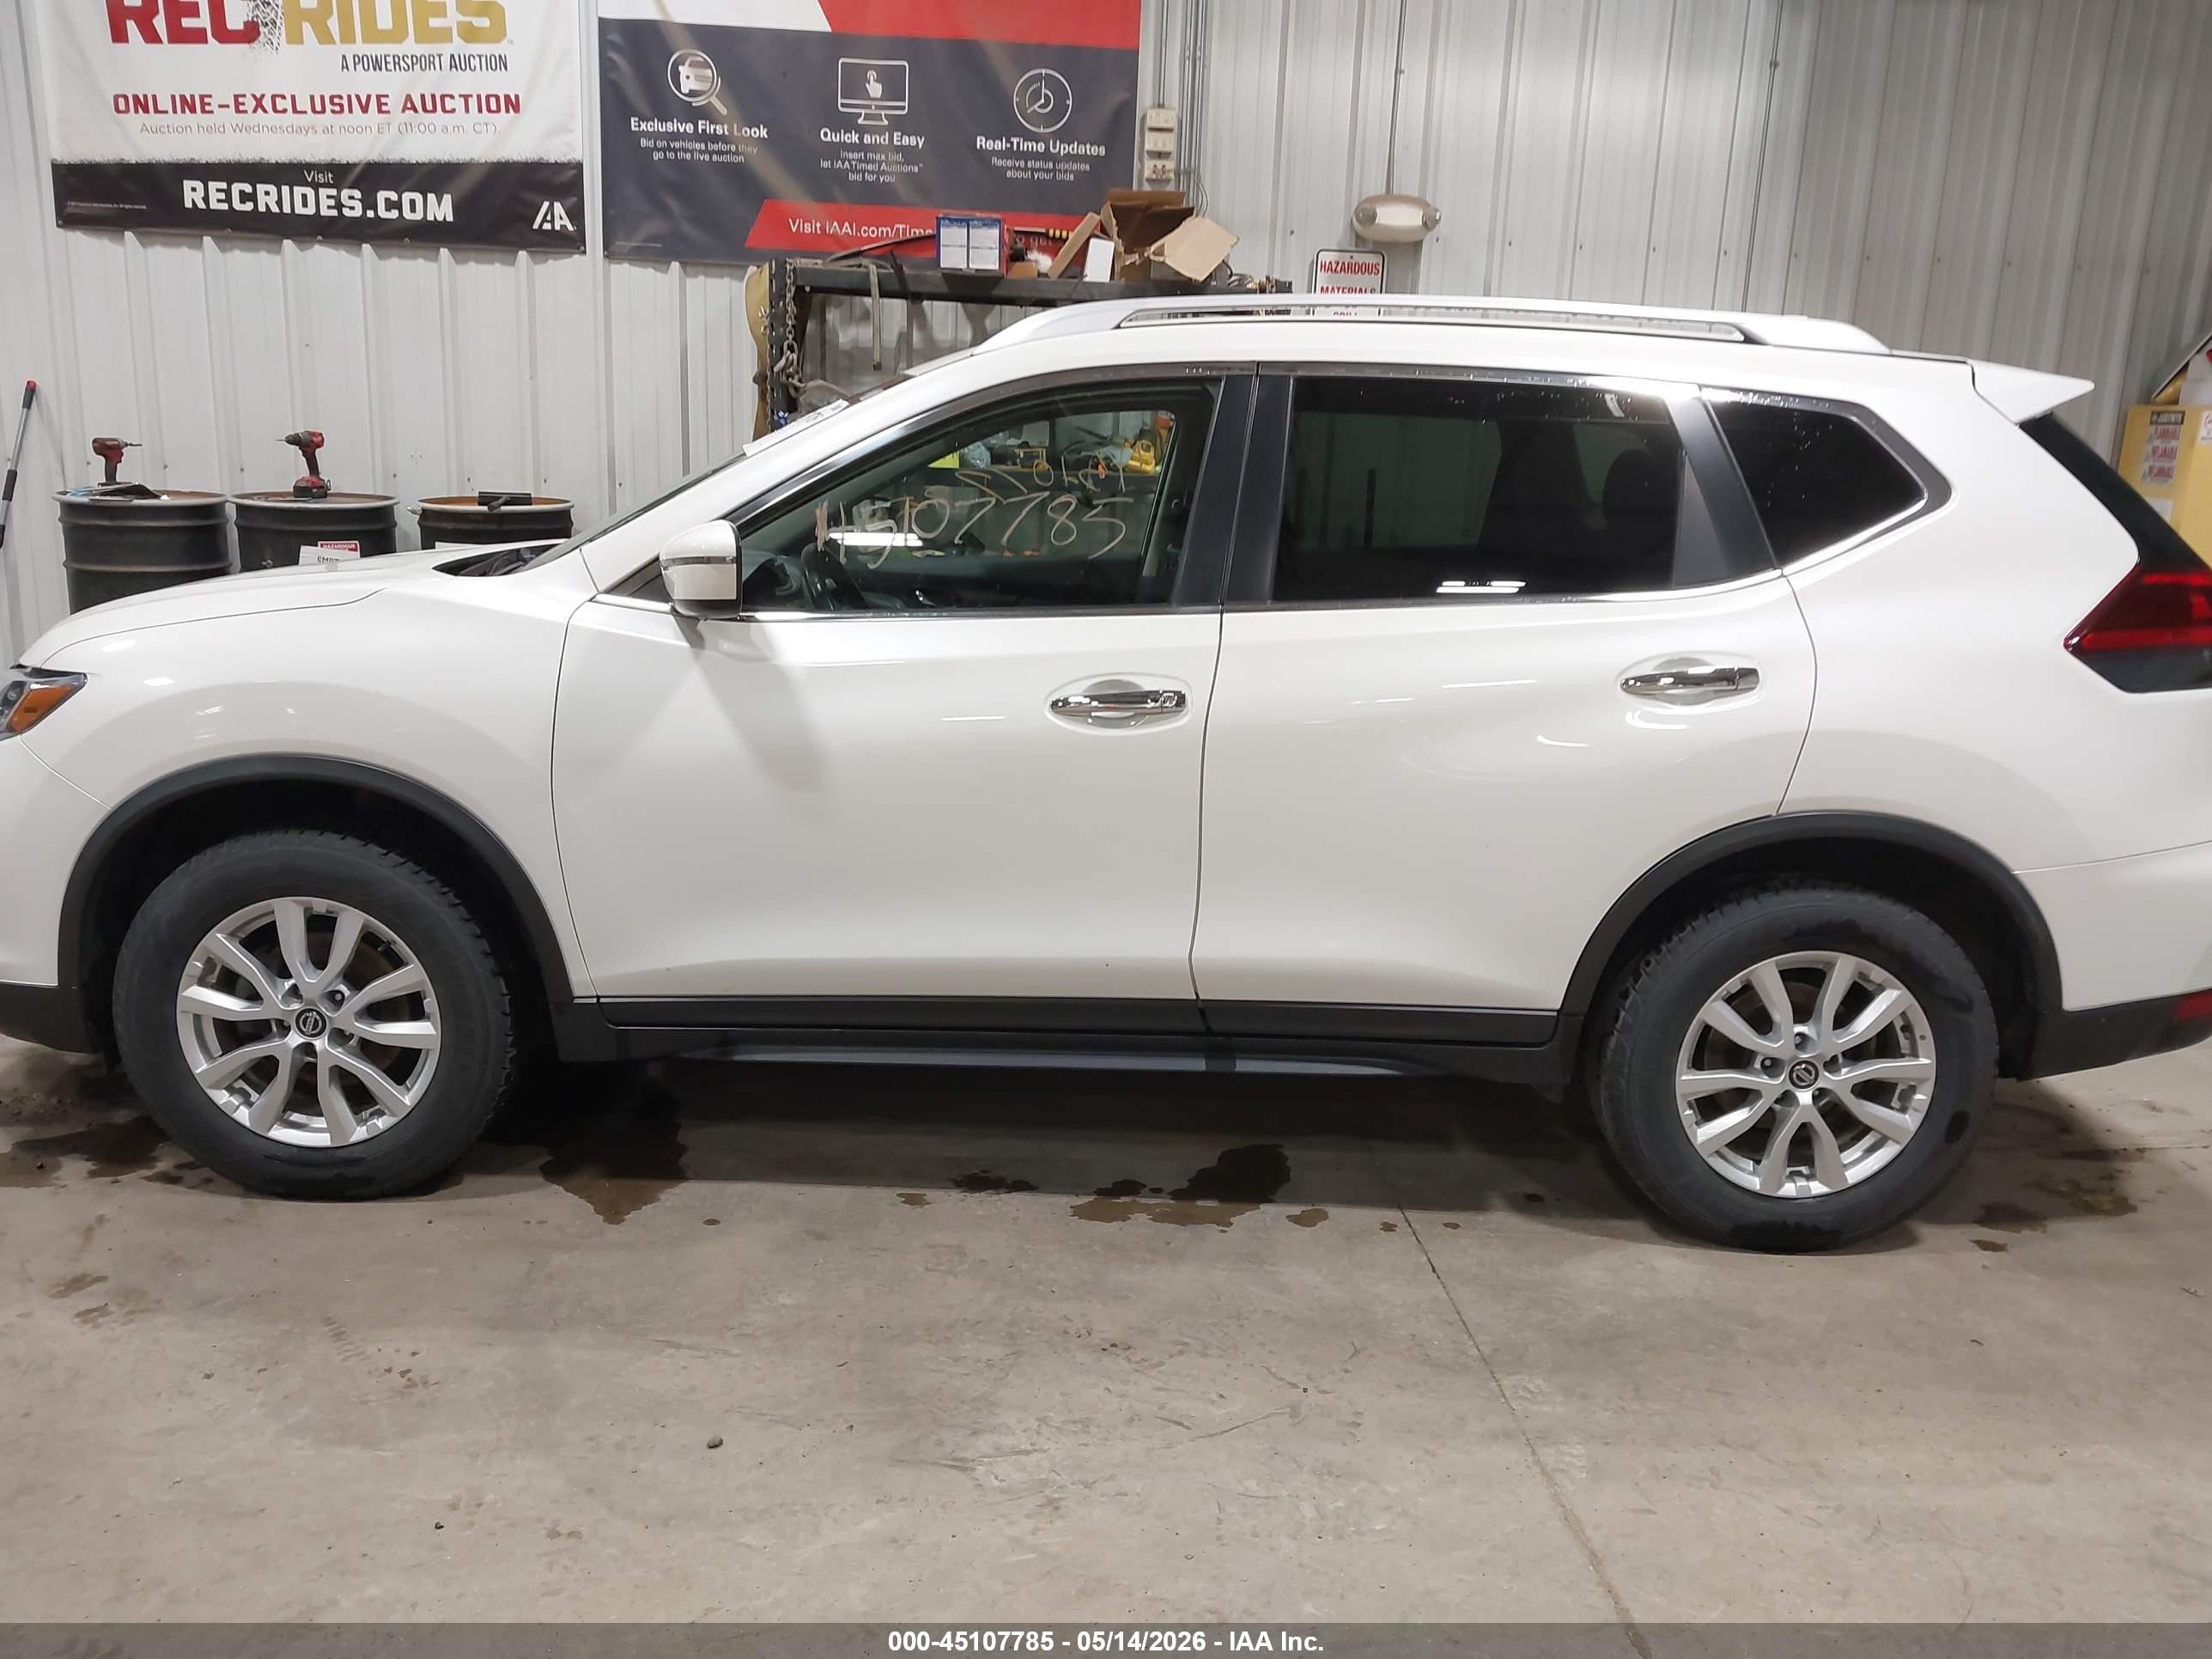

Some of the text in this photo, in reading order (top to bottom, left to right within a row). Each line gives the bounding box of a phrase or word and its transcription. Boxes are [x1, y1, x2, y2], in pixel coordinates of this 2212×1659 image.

[341, 54, 508, 72] A POWERSPORT AUCTION
[112, 94, 521, 115] ONLINE-EXCLUSIVE AUCTION
[140, 123, 192, 135] Auction
[198, 123, 225, 135] held
[231, 123, 317, 137] Wednesdays
[322, 124, 335, 135] at
[339, 125, 373, 135] noon
[378, 123, 392, 135] ET
[398, 122, 436, 137] (11:00
[441, 125, 467, 135] a.m.
[630, 116, 769, 138] Exclusive First Look
[640, 137, 757, 155] Bid on vehicles before they
[820, 127, 925, 149] Quick and Easy
[976, 136, 1106, 156] Real-Time Updates
[653, 150, 744, 163] go to the live auction
[821, 158, 831, 168] let
[841, 149, 904, 162] Insert max bid,
[991, 156, 1090, 172] Receive status updates
[303, 170, 334, 184] Visit
[848, 172, 896, 184] bid for you
[1006, 169, 1074, 181] about your bids
[182, 179, 454, 222] RECRIDES.COM
[787, 218, 821, 234] Visit
[1320, 260, 1380, 276] HAZARDOUS
